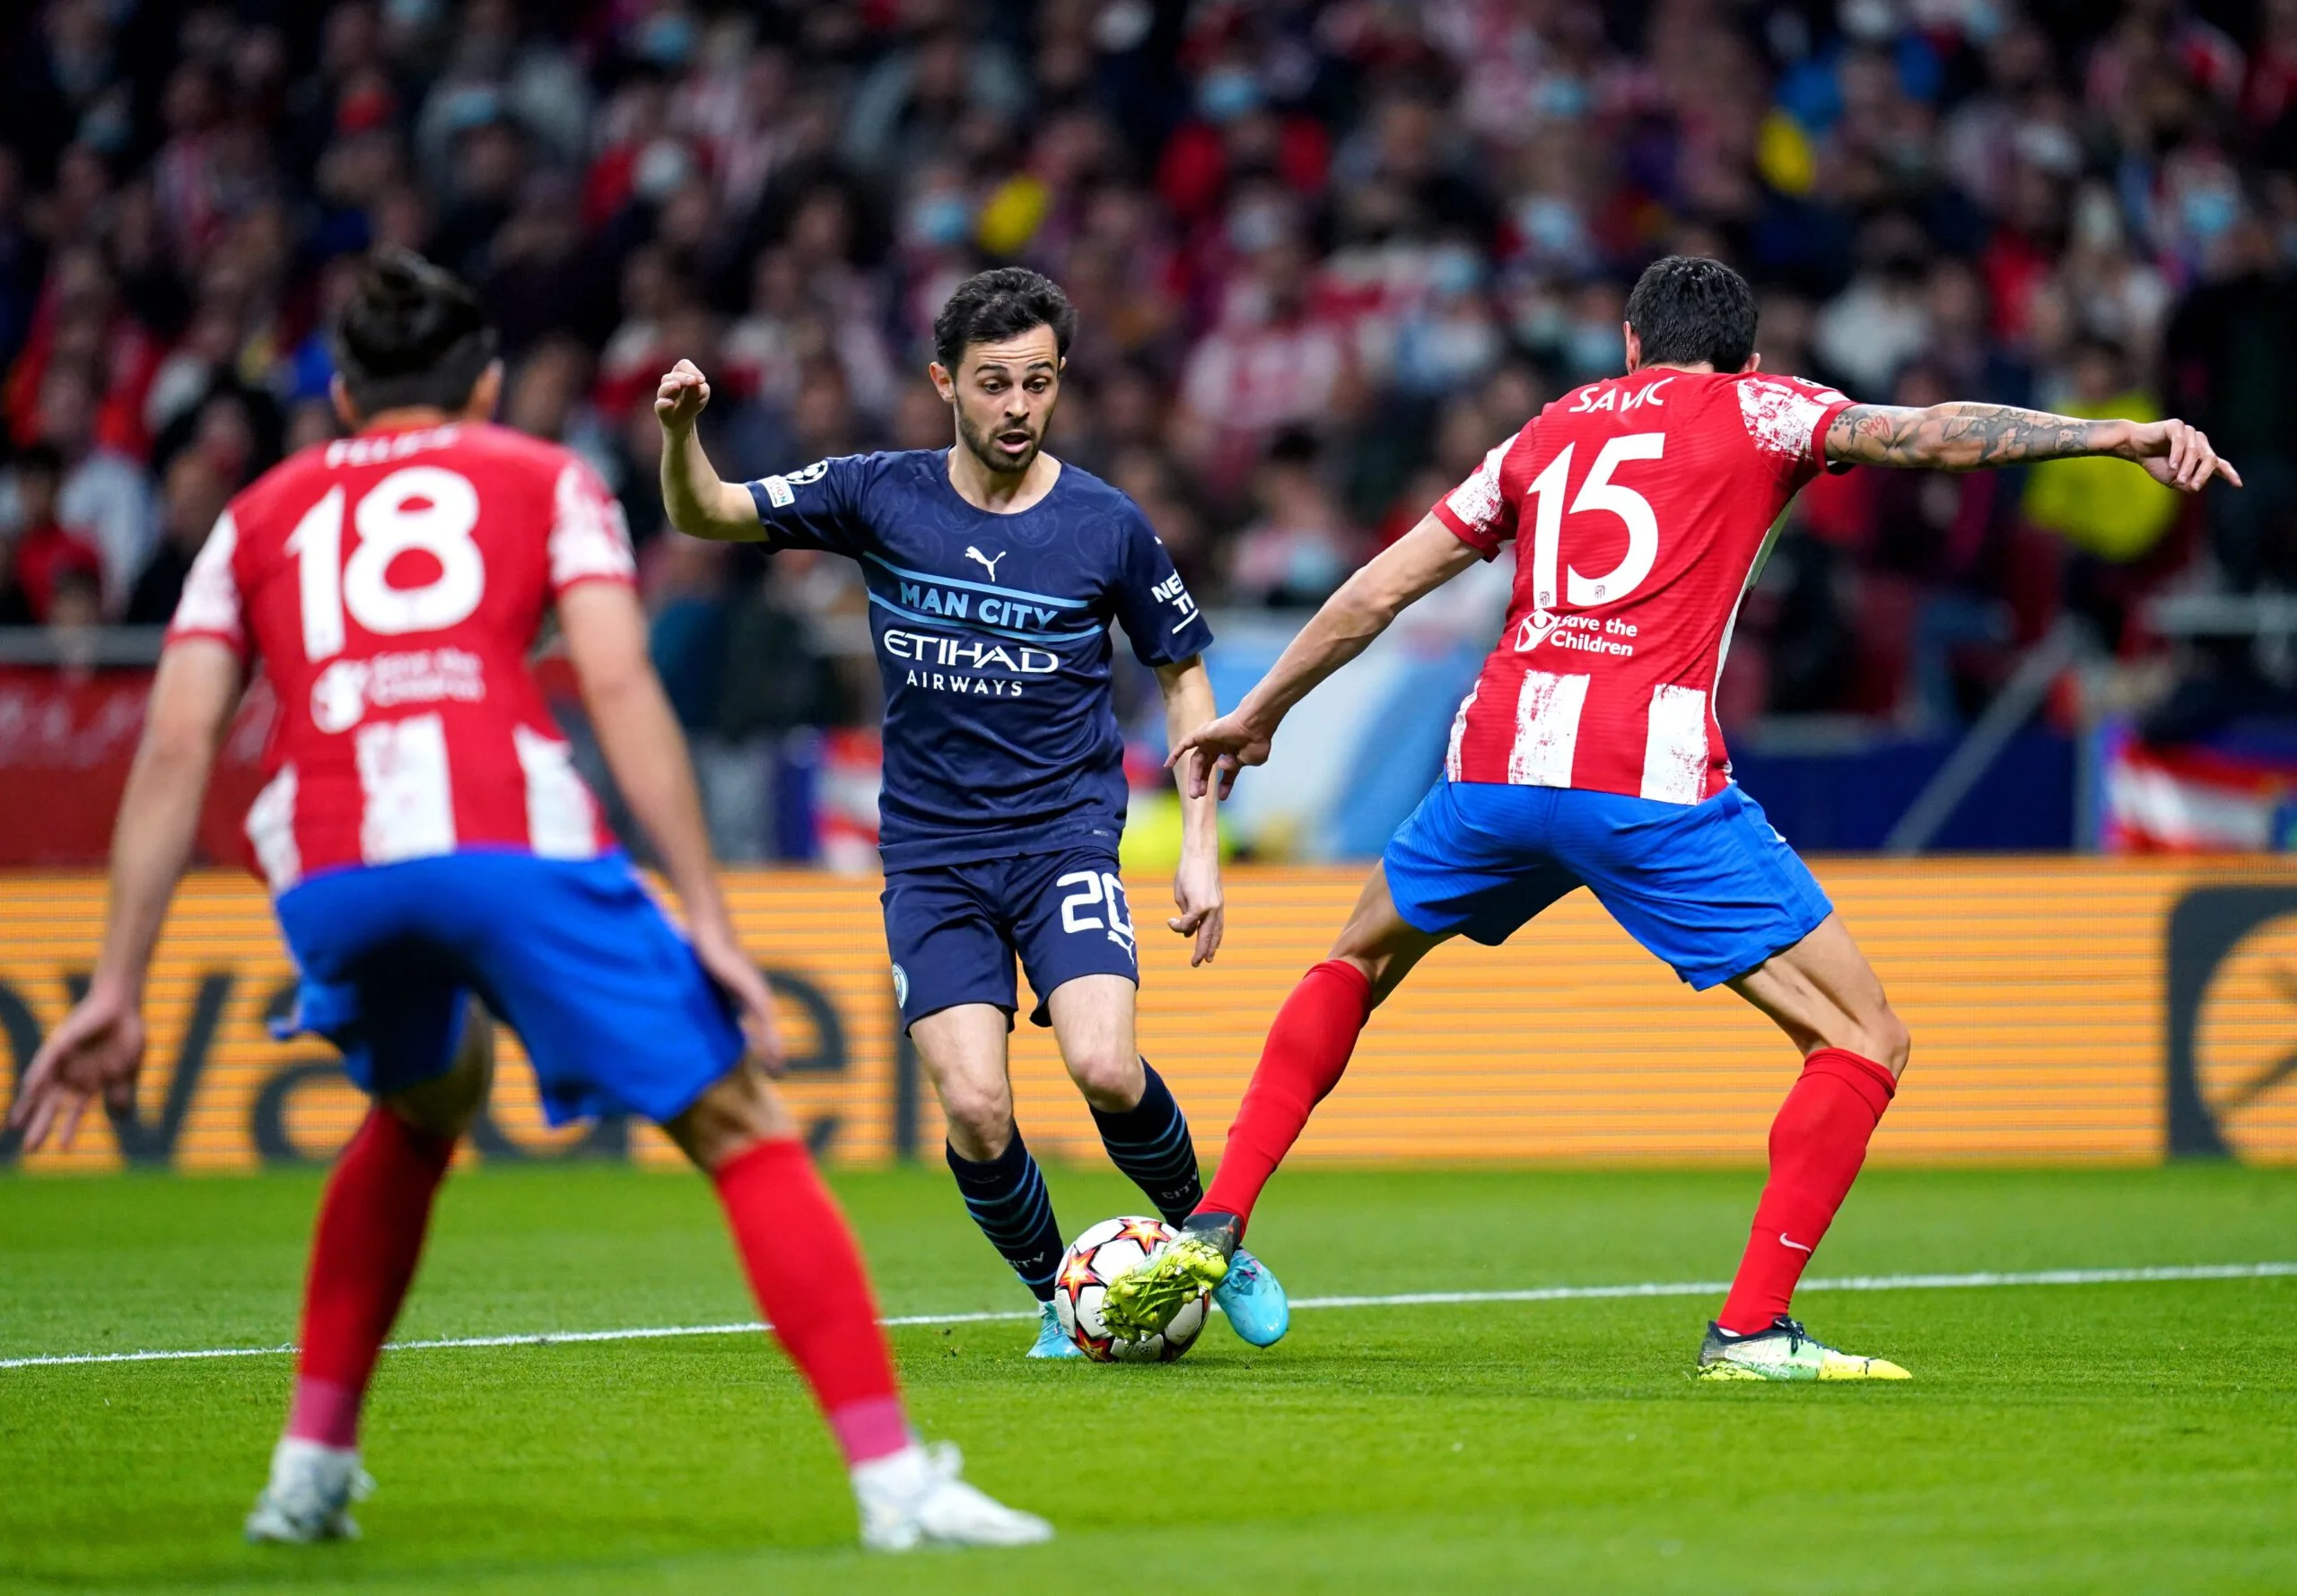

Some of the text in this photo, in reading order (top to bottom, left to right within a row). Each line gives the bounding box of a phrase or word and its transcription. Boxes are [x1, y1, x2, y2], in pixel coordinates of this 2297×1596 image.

[1527, 432, 1665, 609] 15
[284, 465, 485, 664] 18
[1151, 569, 1184, 603] NE
[900, 581, 1059, 630] MAN CITY
[1605, 618, 1638, 637] the
[884, 629, 1060, 674] ETIHAD
[1550, 630, 1633, 657] Children
[906, 669, 1023, 697] AIRWAYS
[1056, 870, 1135, 942] 20
